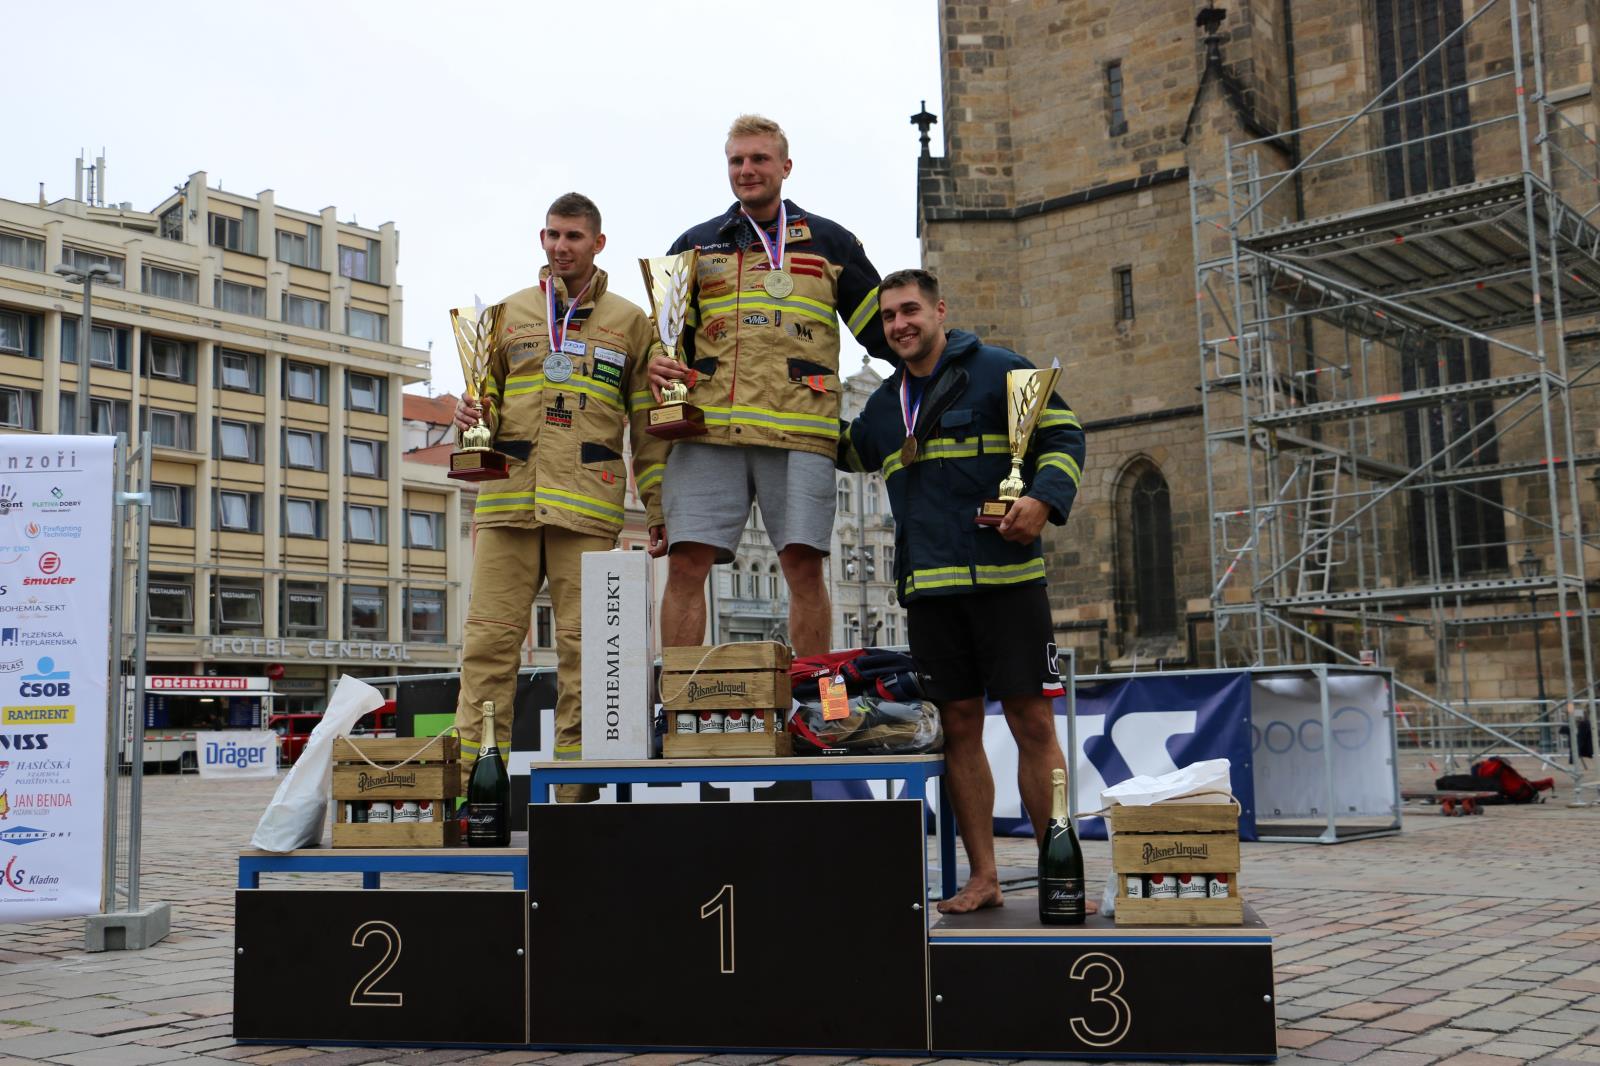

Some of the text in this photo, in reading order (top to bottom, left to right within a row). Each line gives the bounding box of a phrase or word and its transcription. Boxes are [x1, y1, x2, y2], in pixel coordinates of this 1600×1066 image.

[211, 637, 410, 660] HOTEL CENTRAL
[607, 571, 621, 741] BOHEMIA SEKT
[20, 682, 70, 697] ČSOB
[152, 677, 248, 689] OBČERSTVENÍ
[687, 680, 747, 703] Pilsner Urquell
[8, 709, 69, 720] RAMIRENT
[206, 741, 267, 769] Dräger
[359, 770, 416, 793] Pilsner Urquell
[14, 793, 72, 808] JAN BENDA
[1142, 841, 1208, 865] Pilsner Urquell
[28, 874, 60, 885] Kladno
[701, 885, 735, 974] 1
[350, 920, 404, 1007] 2
[1069, 952, 1131, 1047] 3
